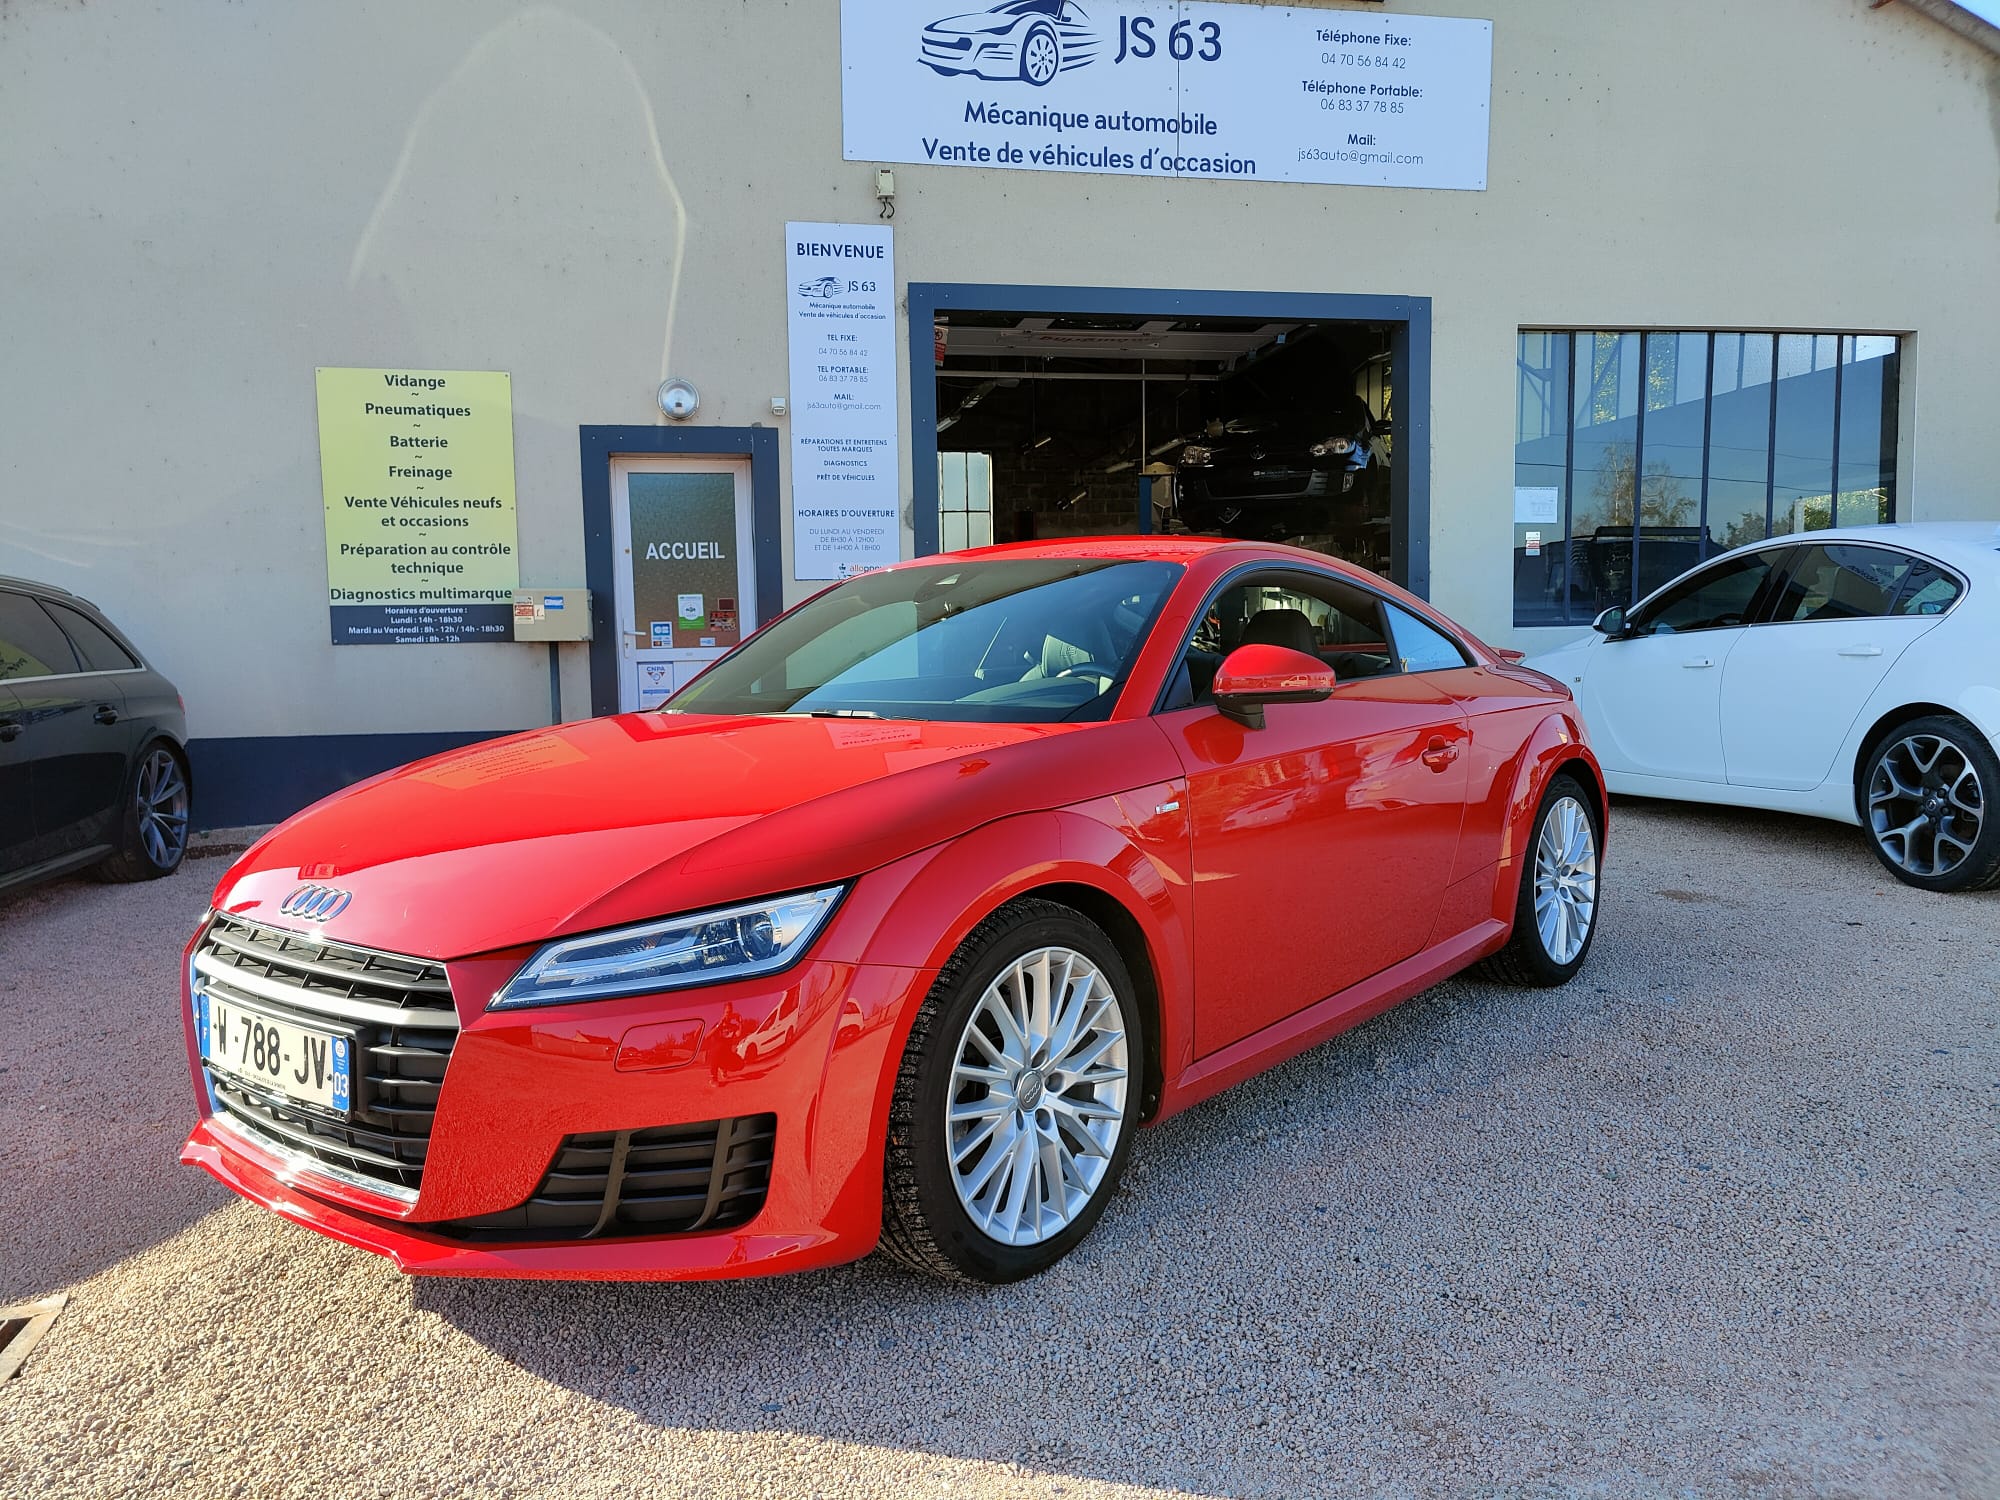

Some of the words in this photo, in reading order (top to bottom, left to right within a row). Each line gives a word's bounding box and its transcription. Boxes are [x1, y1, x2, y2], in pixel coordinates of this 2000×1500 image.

[1114, 17, 1156, 64] JS
[1169, 21, 1222, 62] 63
[1316, 29, 1380, 46] Téléphone
[1384, 34, 1412, 46] Fixe:
[1321, 52, 1336, 64] 04
[1340, 54, 1354, 66] 70
[1357, 56, 1371, 66] 56
[1375, 56, 1388, 68] 84
[1392, 58, 1406, 69] 42
[1302, 80, 1366, 95] Téléphone
[1370, 84, 1423, 98] Portable:
[1320, 98, 1335, 110] 06
[1338, 99, 1352, 111] 83
[1356, 100, 1370, 112] 37
[1373, 101, 1387, 113] 78
[1390, 102, 1404, 114] 85
[965, 102, 1089, 132] Mécanique
[1094, 108, 1217, 136] automobile
[1347, 134, 1376, 146] Mail:
[923, 138, 991, 163] Vente
[996, 140, 1024, 165] de
[1030, 142, 1134, 169] véhicules
[1140, 148, 1256, 174] d'occasion
[1298, 148, 1424, 164] js63auto@gmail.com
[797, 242, 884, 258] BIENVENUE
[848, 282, 858, 292] JS
[862, 282, 875, 292] 63
[385, 375, 445, 389] Vidange
[365, 403, 471, 417] Pneumatiques
[390, 436, 448, 448] Batterie
[389, 466, 452, 480] Freinage
[842, 473, 874, 481] VÉHICULES
[345, 497, 387, 508] Vente
[390, 496, 459, 508] Véhicules
[463, 497, 502, 508] neufs
[381, 516, 395, 527] et
[400, 516, 469, 527] occasions
[341, 544, 427, 558] Préparation
[431, 546, 448, 555] au
[452, 544, 510, 555] contrôle
[646, 542, 725, 560] ACCUEIL
[391, 563, 463, 576] technique
[331, 589, 415, 602] Diagnostics
[334, 1072, 348, 1096] 03
